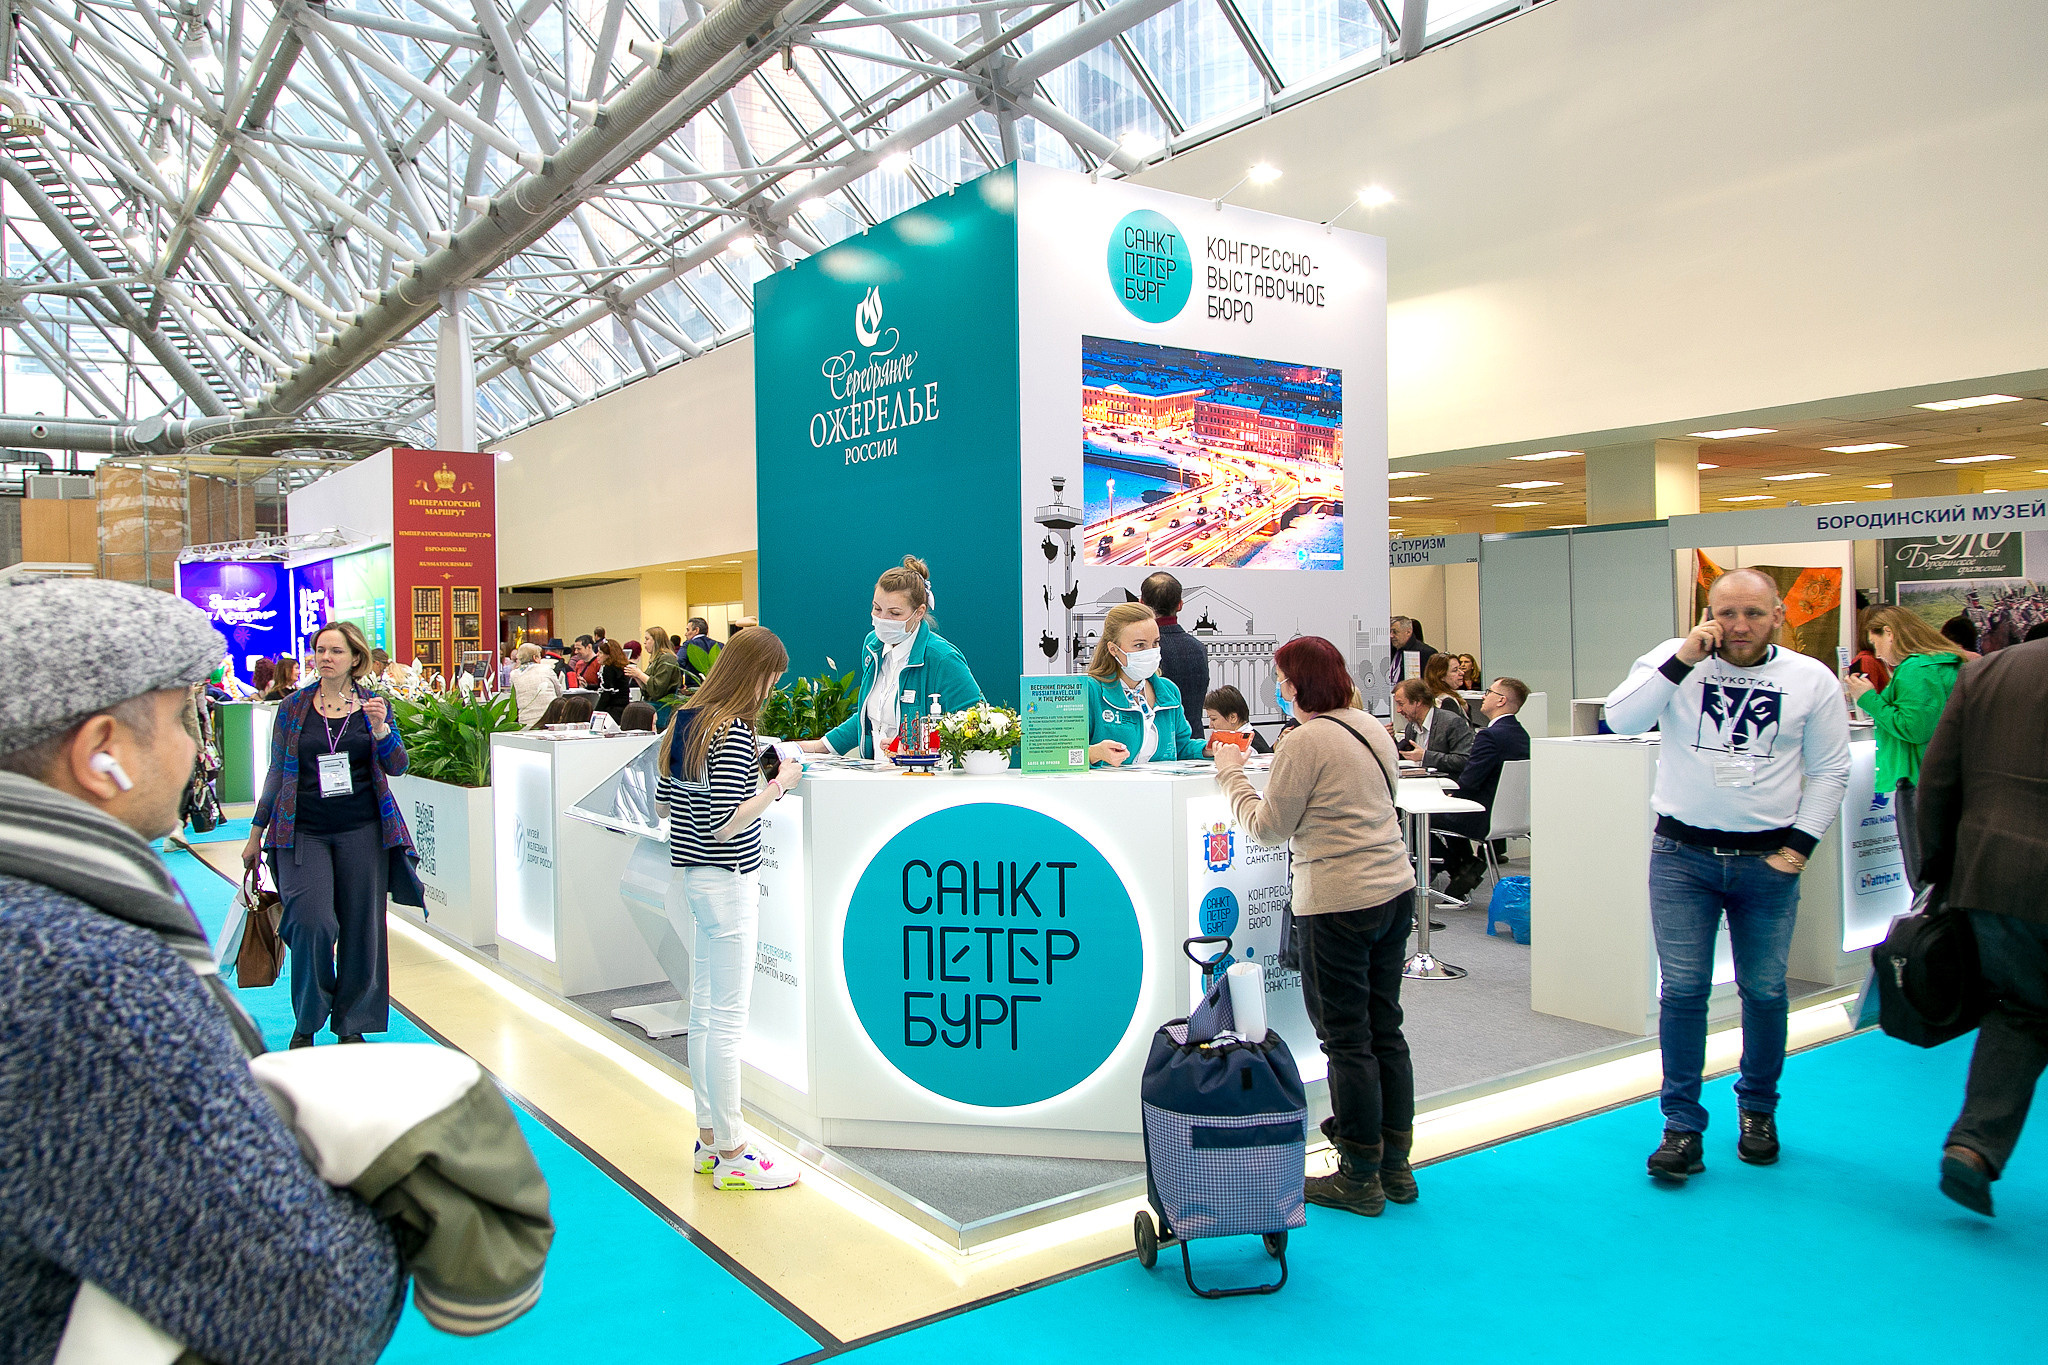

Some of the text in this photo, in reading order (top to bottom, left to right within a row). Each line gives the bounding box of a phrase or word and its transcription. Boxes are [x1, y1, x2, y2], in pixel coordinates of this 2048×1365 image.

[1124, 226, 1176, 256] САНКТ
[1207, 235, 1319, 277] КОНГРЕССНО-
[1124, 251, 1177, 281] ПЕТЕР
[1125, 277, 1167, 304] БУРГ
[1207, 265, 1325, 308] ВЫСТАВОЧНОЕ
[1207, 294, 1254, 324] БЮРО
[822, 327, 918, 412] Серебряное
[809, 381, 940, 449] ОЖЕРЕЛЬЕ
[844, 437, 898, 466] РОССИИ
[408, 499, 481, 508] ИМПЕРАТОРСКИЙ
[425, 508, 466, 517] МАРШРУТ
[1817, 499, 2047, 531] БОРОДИНСКИЙ МУЗЕЙ
[1389, 537, 1446, 553] С-ТУРИЗМ
[1397, 551, 1429, 564] КЛЮЧ
[1711, 674, 1775, 689] ЧУКОТКА
[762, 819, 772, 830] FOR
[526, 828, 539, 839] МУЗЕЙ
[768, 846, 776, 855] OF
[1245, 851, 1287, 866] САНКТ-ПЕТ
[761, 858, 779, 870] SBURG
[903, 859, 1078, 918] САНКТ
[1247, 884, 1292, 902] КОНГРЕСС
[1206, 895, 1231, 910] САНКТ
[1248, 899, 1288, 916] ВЫСТАВО
[1206, 907, 1232, 922] ПЕТЕР
[1248, 915, 1272, 930] БЮРО
[1206, 920, 1227, 934] БУРГ
[761, 953, 778, 969] TOURIST
[763, 943, 793, 963] PETERSBURG
[903, 925, 1080, 985] ПЕТЕР
[779, 971, 798, 987] BUREAU
[904, 991, 1042, 1051] БУРГ
